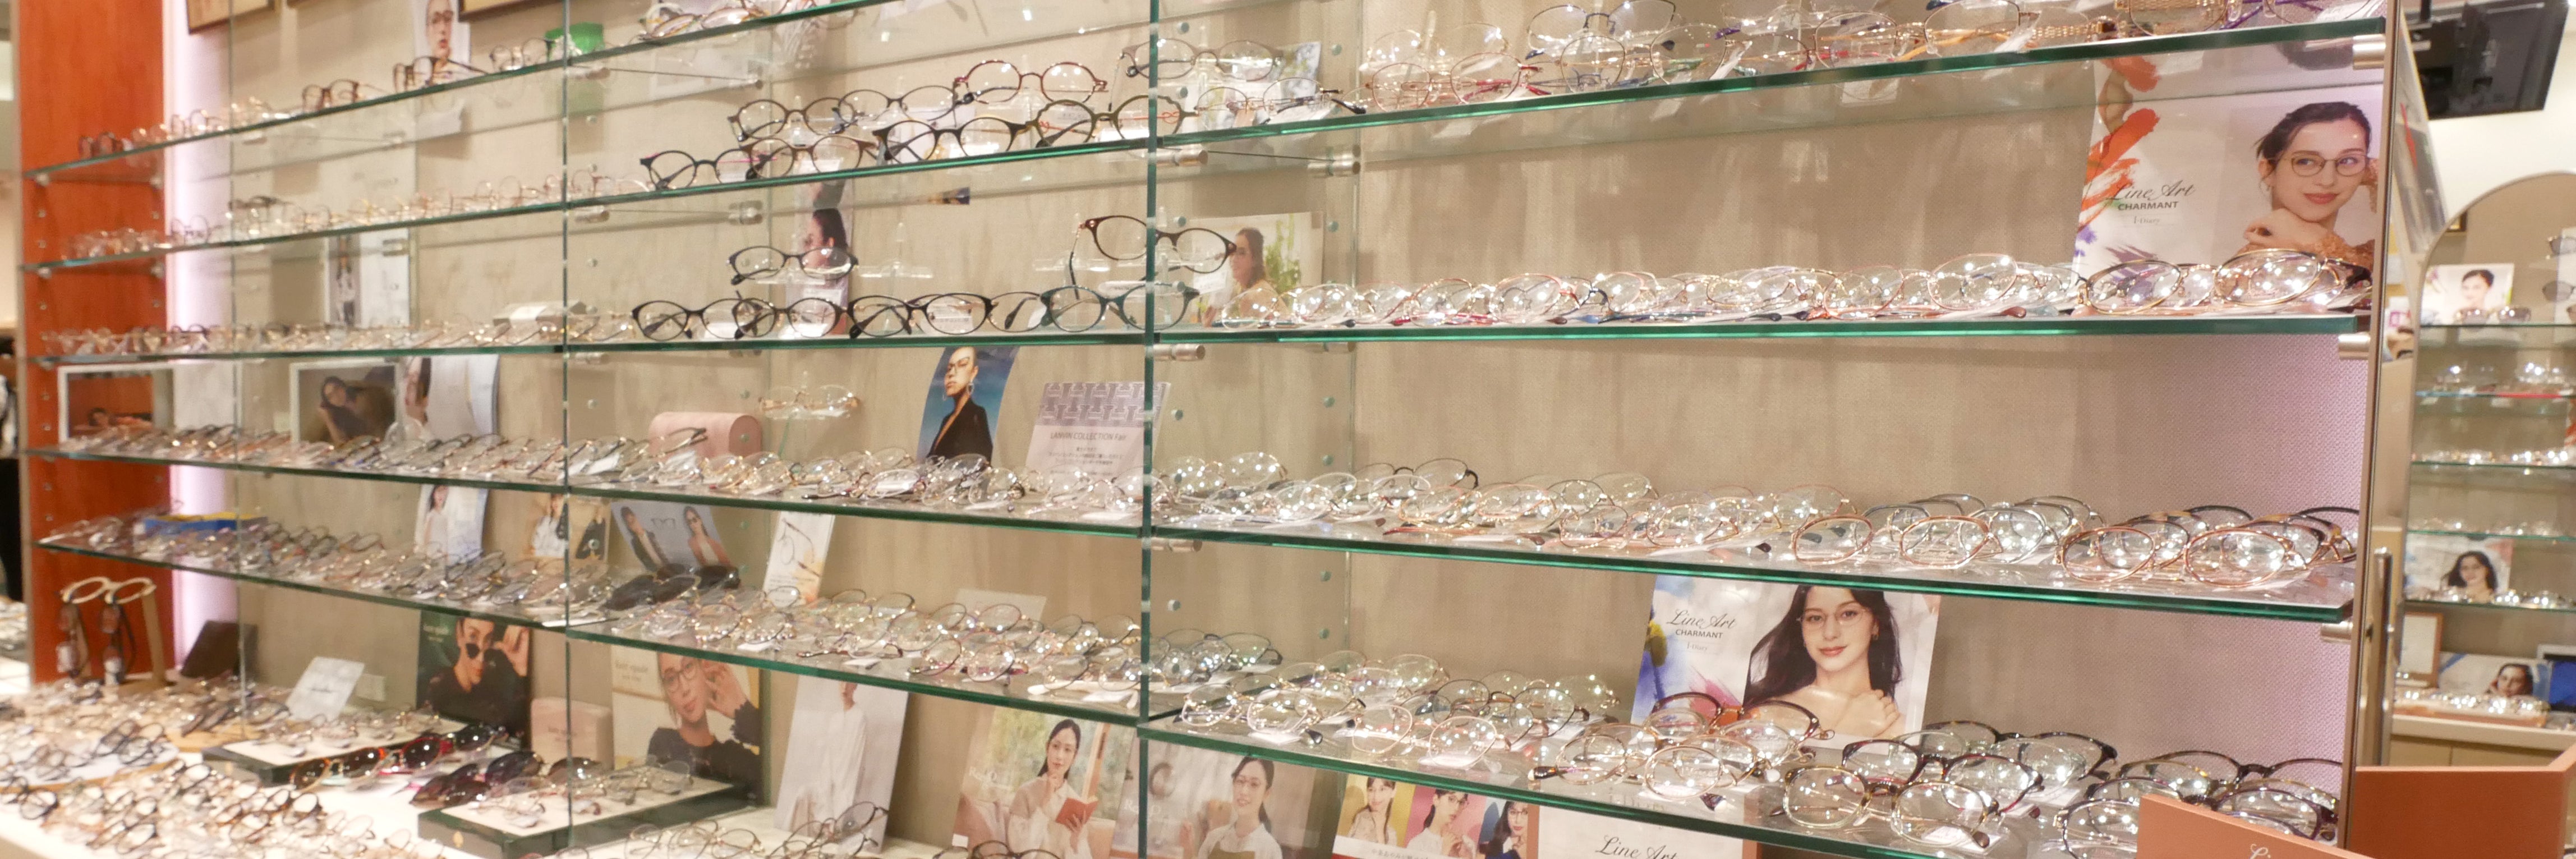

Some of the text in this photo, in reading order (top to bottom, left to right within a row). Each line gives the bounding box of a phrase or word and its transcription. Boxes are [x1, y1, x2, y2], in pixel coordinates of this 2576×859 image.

[2105, 180, 2195, 200] Line Art
[2118, 201, 2179, 211] CHARMANT
[1073, 432, 1114, 440] COLLECTION
[1666, 609, 1737, 629] Line Art
[1675, 629, 1723, 639] CHARMANT
[1595, 835, 1640, 859] Line
